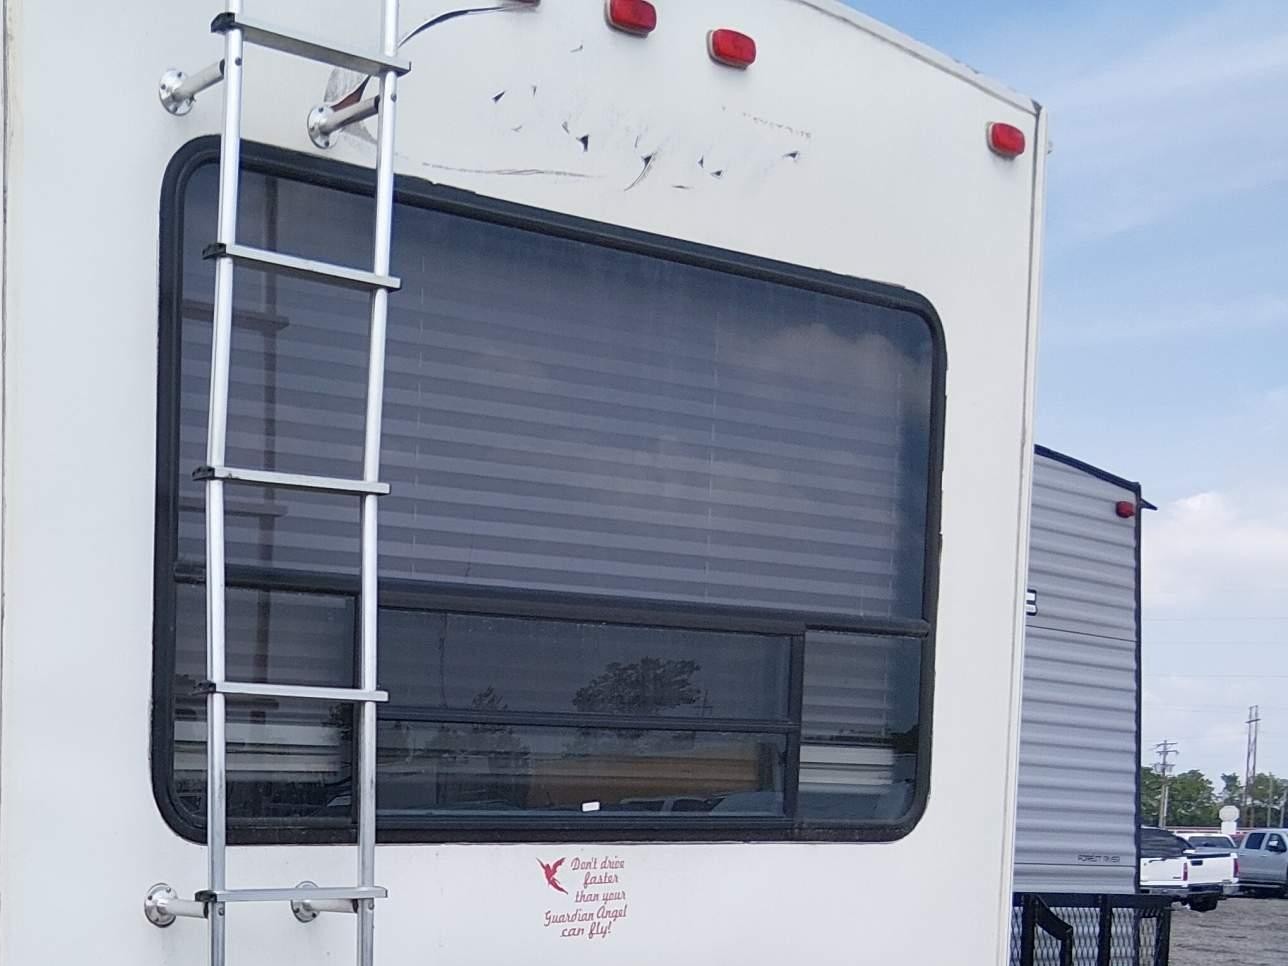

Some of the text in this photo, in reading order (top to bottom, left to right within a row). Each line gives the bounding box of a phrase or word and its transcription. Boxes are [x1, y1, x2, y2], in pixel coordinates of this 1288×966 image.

[570, 855, 625, 871] Don't drive
[583, 871, 619, 889] faster
[574, 889, 626, 905] than your
[543, 904, 628, 927] Guardian Angel
[560, 920, 612, 940] can fly!
